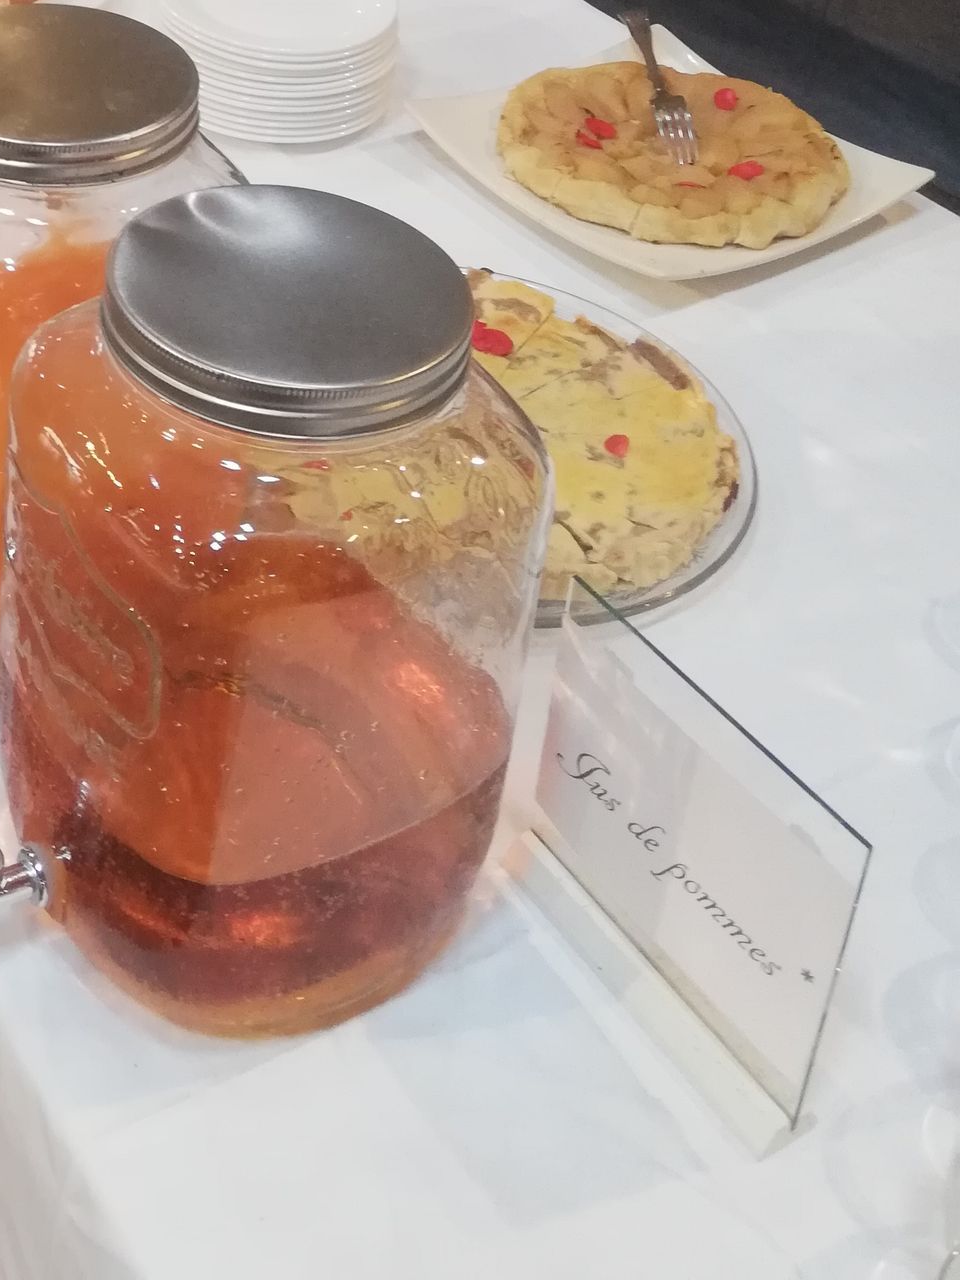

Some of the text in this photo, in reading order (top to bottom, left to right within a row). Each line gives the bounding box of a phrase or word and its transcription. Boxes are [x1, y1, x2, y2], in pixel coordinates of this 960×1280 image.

[556, 751, 783, 977] Jus de pommes
